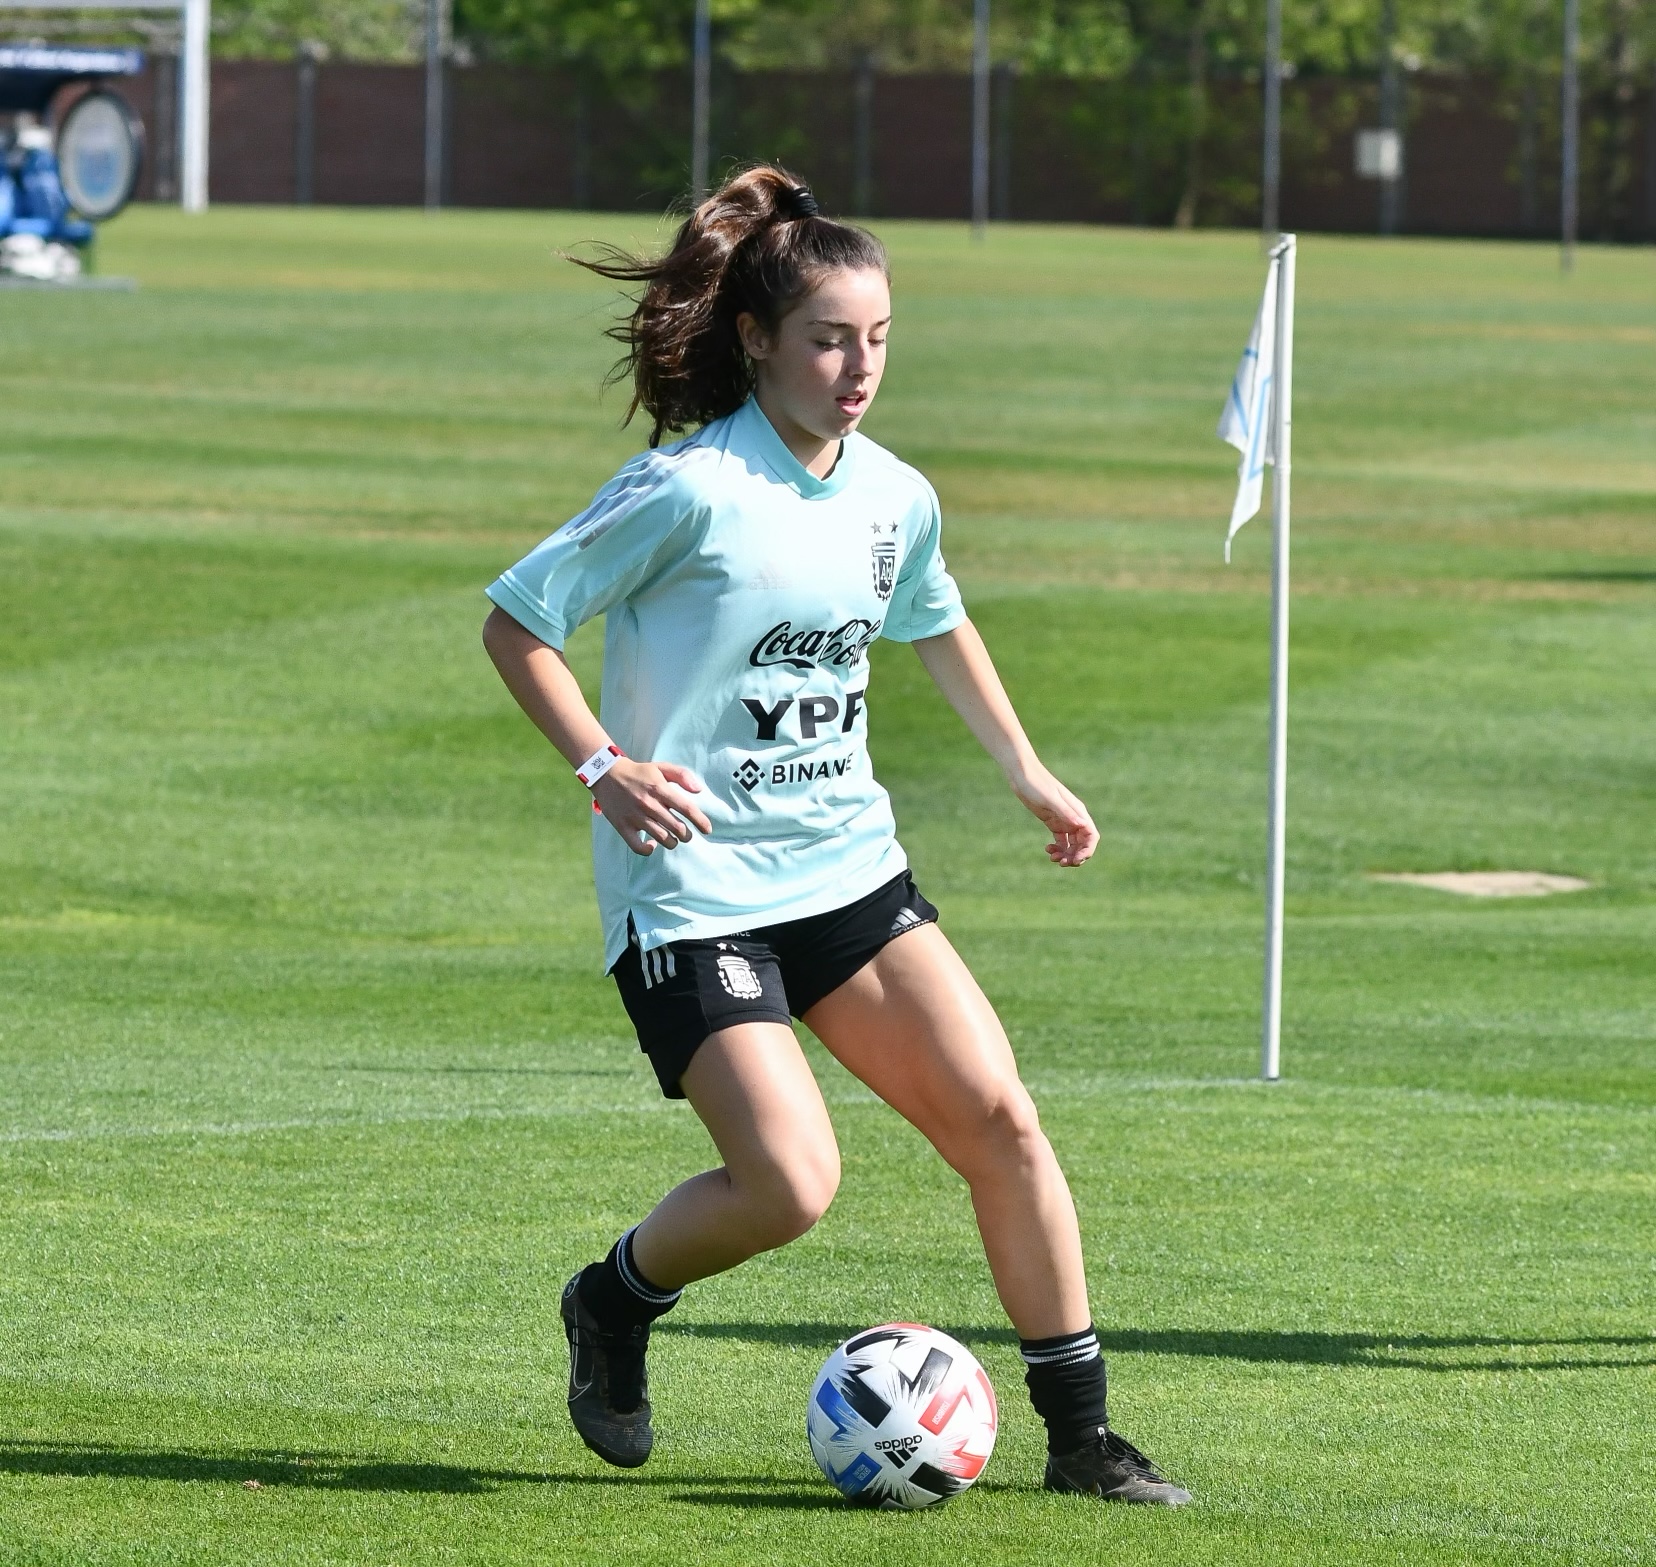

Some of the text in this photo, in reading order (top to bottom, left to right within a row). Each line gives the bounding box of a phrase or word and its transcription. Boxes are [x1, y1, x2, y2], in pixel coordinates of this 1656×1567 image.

[739, 689, 864, 741] YPF
[771, 753, 853, 784] BINANE
[874, 1434, 923, 1451] adidas
